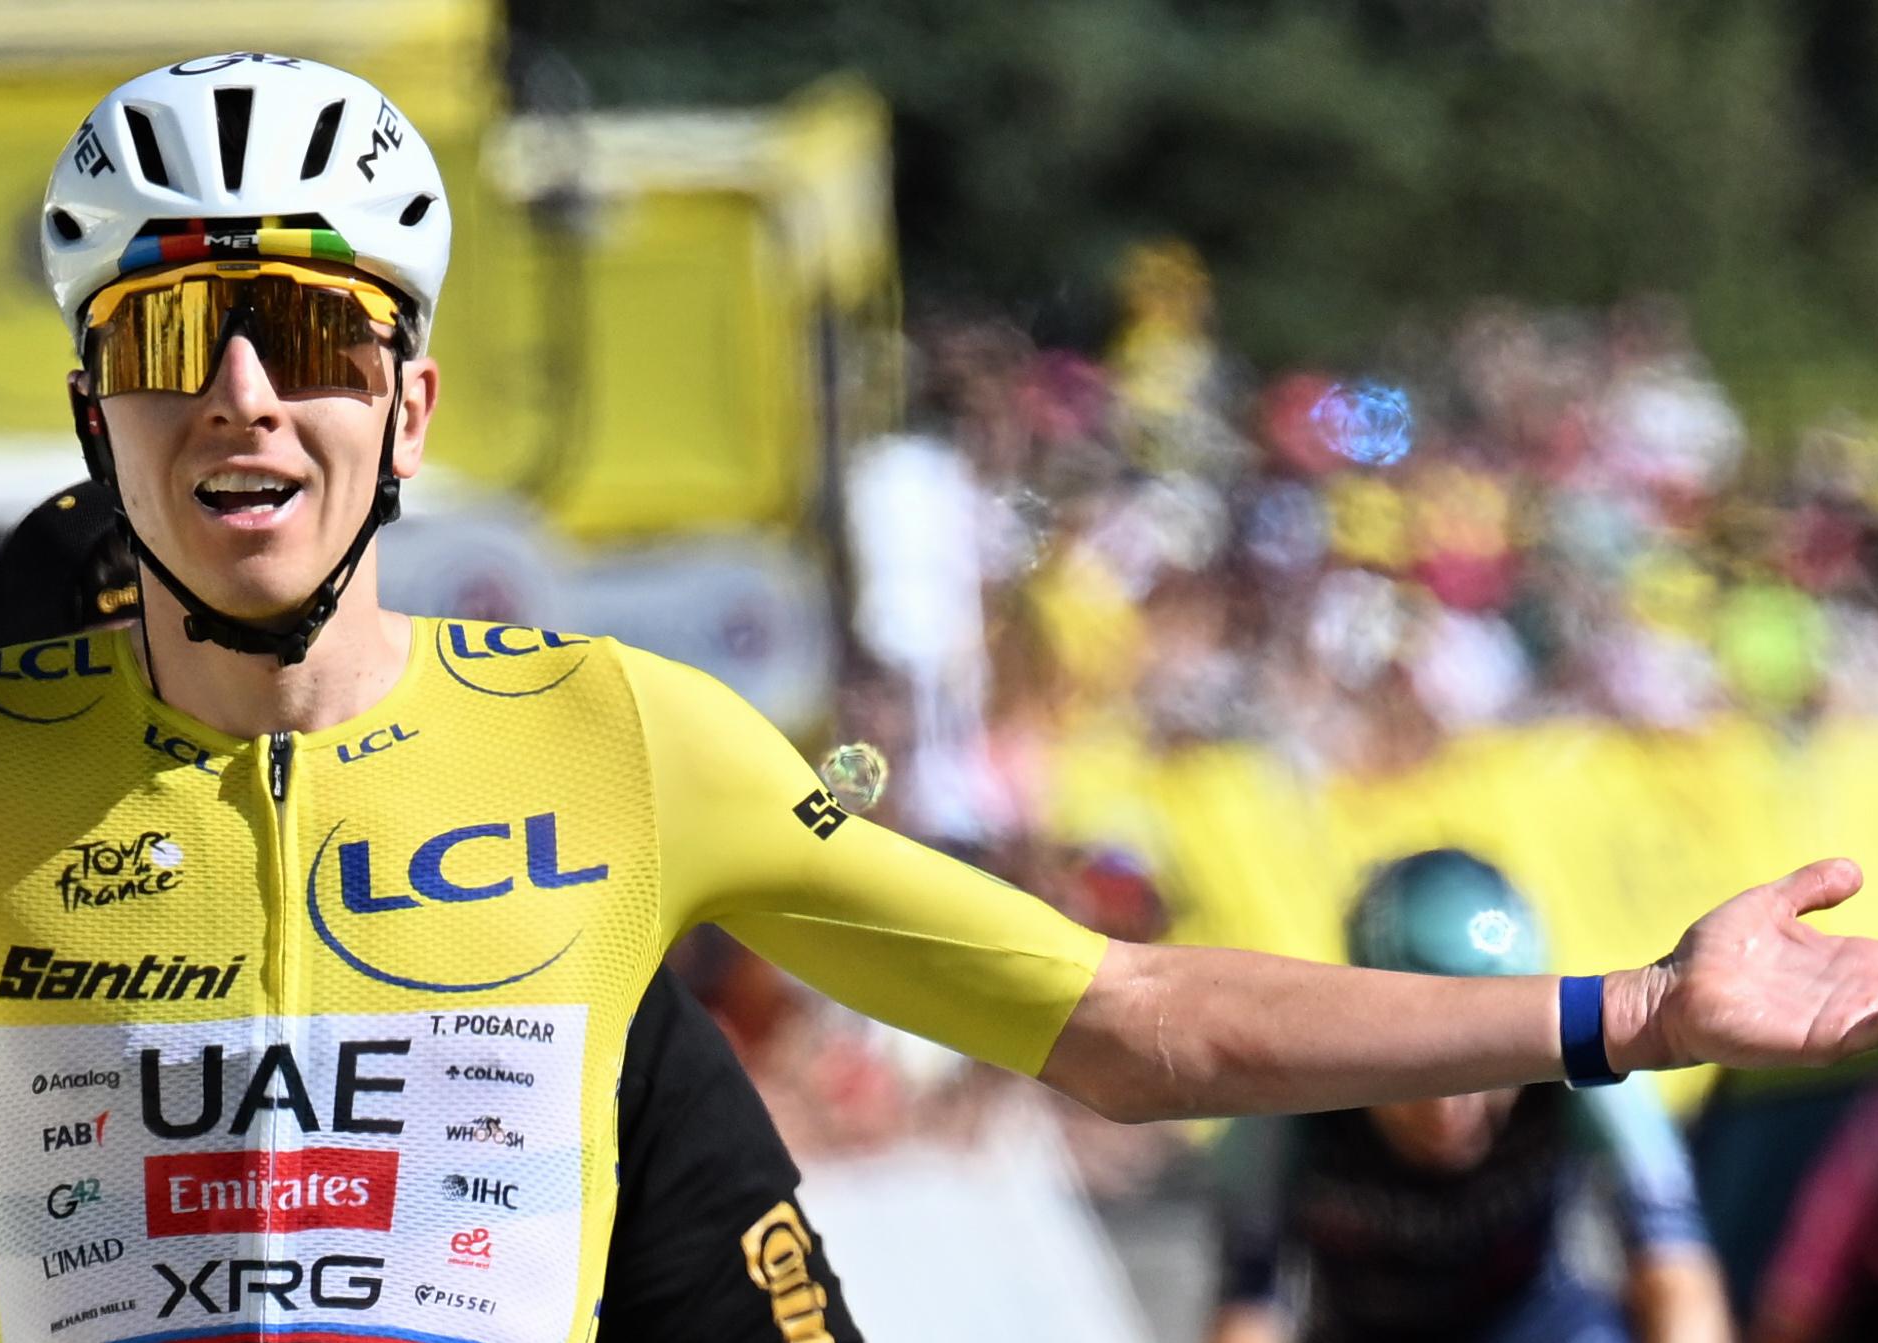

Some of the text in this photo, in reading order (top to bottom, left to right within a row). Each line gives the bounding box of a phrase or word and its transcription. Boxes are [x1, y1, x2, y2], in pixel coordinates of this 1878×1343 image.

[357, 97, 403, 183] MET
[449, 622, 591, 660] LCL
[143, 724, 220, 777] LCL
[336, 723, 420, 764] LCL
[337, 812, 609, 914] LCL
[430, 1014, 555, 1044] T. POGACAR
[49, 1069, 120, 1091] Analog
[140, 1038, 412, 1140] UAE
[462, 1065, 535, 1088] COLNAGO
[46, 1178, 101, 1219] G42
[169, 1174, 371, 1215] Emirates
[471, 1177, 520, 1211] IHC
[41, 1238, 124, 1280] L'IMAD
[152, 1254, 386, 1319] XRG
[433, 1291, 498, 1316] PISSEI
[50, 1299, 136, 1334] RICHARD MILLE
